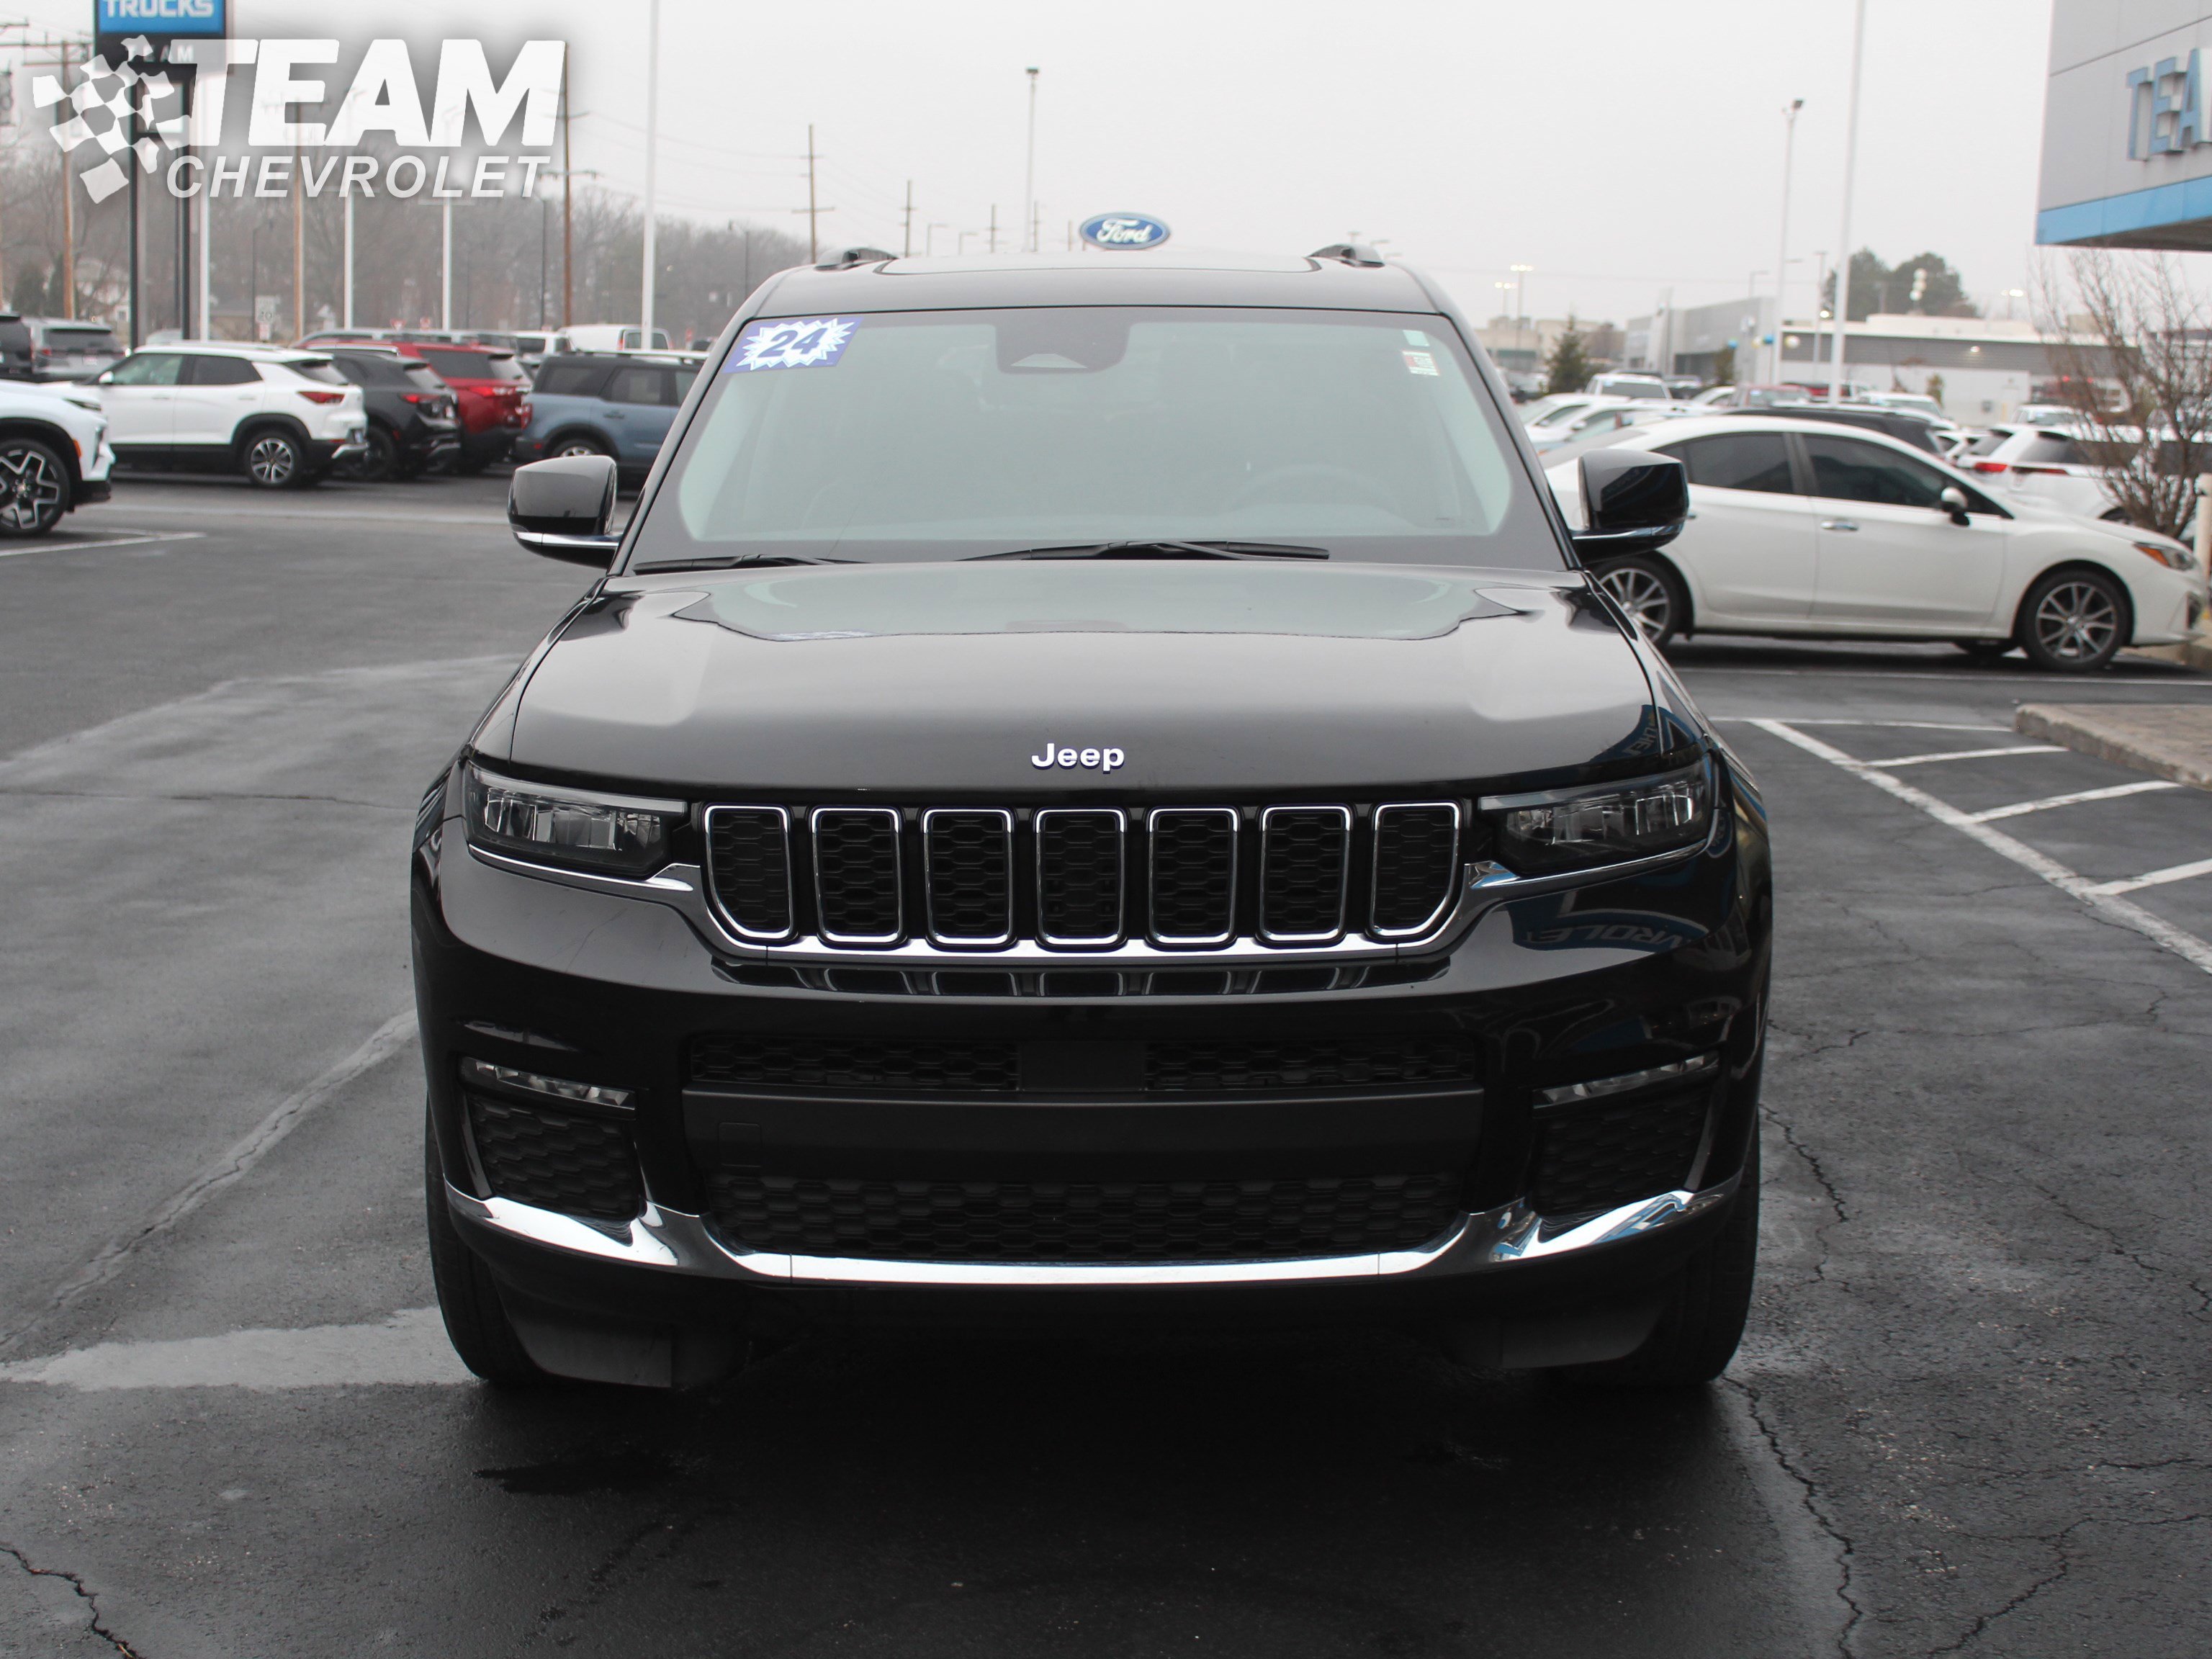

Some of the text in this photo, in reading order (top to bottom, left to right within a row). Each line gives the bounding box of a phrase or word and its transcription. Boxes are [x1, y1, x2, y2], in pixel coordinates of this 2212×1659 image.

[104, 0, 215, 17] TRUCKS
[1096, 217, 1153, 243] Ford
[757, 328, 829, 359] 24
[1031, 742, 1125, 773] Jeep
